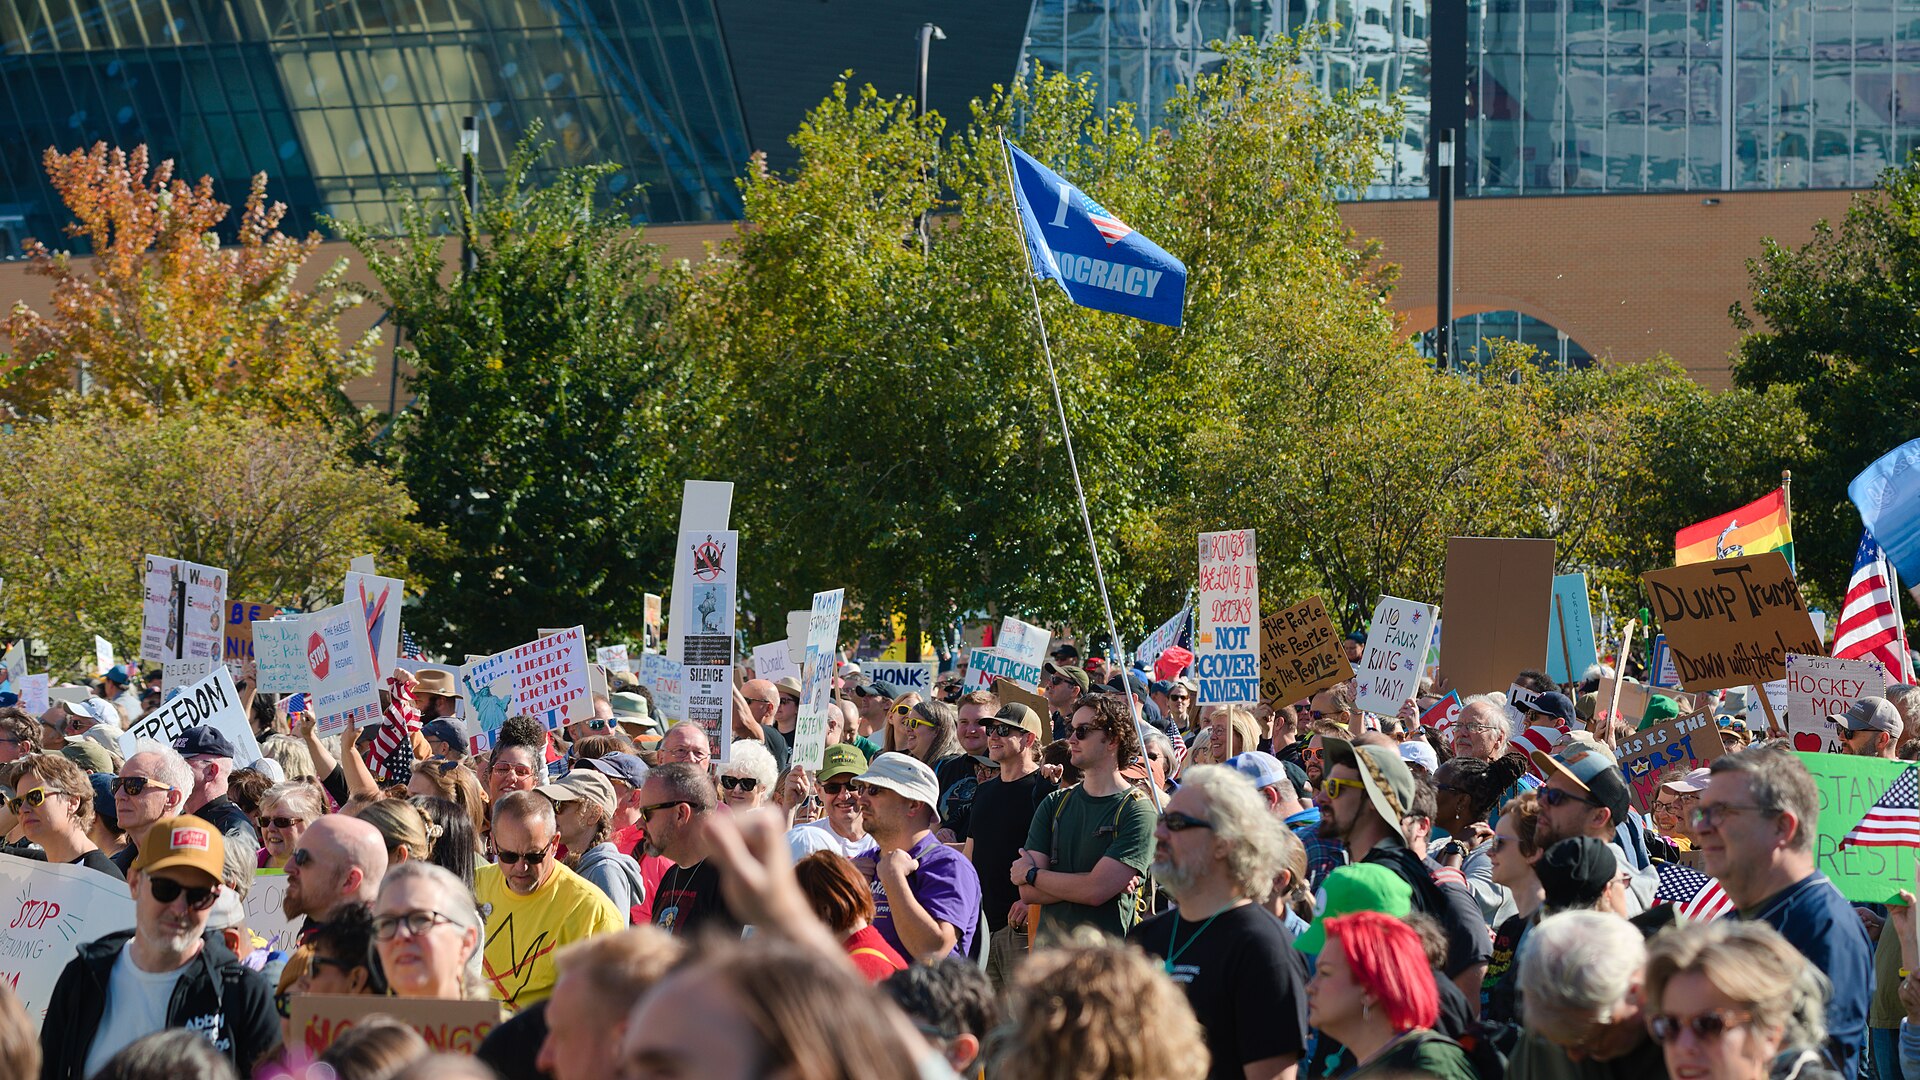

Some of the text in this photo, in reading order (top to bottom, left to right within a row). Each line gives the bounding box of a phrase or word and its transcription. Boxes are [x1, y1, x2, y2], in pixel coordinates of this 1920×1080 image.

[1048, 182, 1074, 230] I
[1211, 531, 1246, 562] KINGS
[190, 568, 213, 588] White
[1200, 565, 1257, 595] BELONG IN
[228, 602, 262, 625] BE
[1211, 597, 1253, 625] DECKS
[1379, 607, 1400, 626] NO
[1571, 591, 1583, 648] CRUELTY
[324, 620, 352, 637] THE FASCIST
[1215, 626, 1250, 650] NOT
[1384, 627, 1418, 650] FAUX
[226, 636, 254, 658] NIC
[308, 642, 328, 671] STOP
[332, 639, 349, 652] TRUMP
[514, 629, 578, 660] FREEDOM
[165, 663, 206, 676] RELEASE
[471, 654, 504, 676] FIGHT
[516, 646, 573, 674] LIBERTY
[969, 650, 1041, 685] HEALTHCARE
[1367, 647, 1401, 672] KING
[1807, 658, 1847, 671] JUST A
[518, 661, 573, 689] JUSTICE
[690, 667, 724, 682] SILENCE
[873, 667, 923, 688] HONK
[1787, 670, 1866, 698] HOCKEY
[319, 694, 336, 706] ANTIFA
[342, 682, 371, 699] ANTI-FASCIST
[519, 677, 569, 703] RIGHTS
[521, 685, 586, 716] EQUALITY
[689, 696, 723, 706] ACCEPTANCE
[1198, 679, 1260, 703] NMENT
[1374, 676, 1404, 702] WAY!
[133, 675, 229, 743] FREEDOM
[1645, 729, 1668, 747] IS
[1674, 712, 1707, 735] THE
[1810, 771, 1887, 815] STAN
[10, 899, 61, 930] STOP
